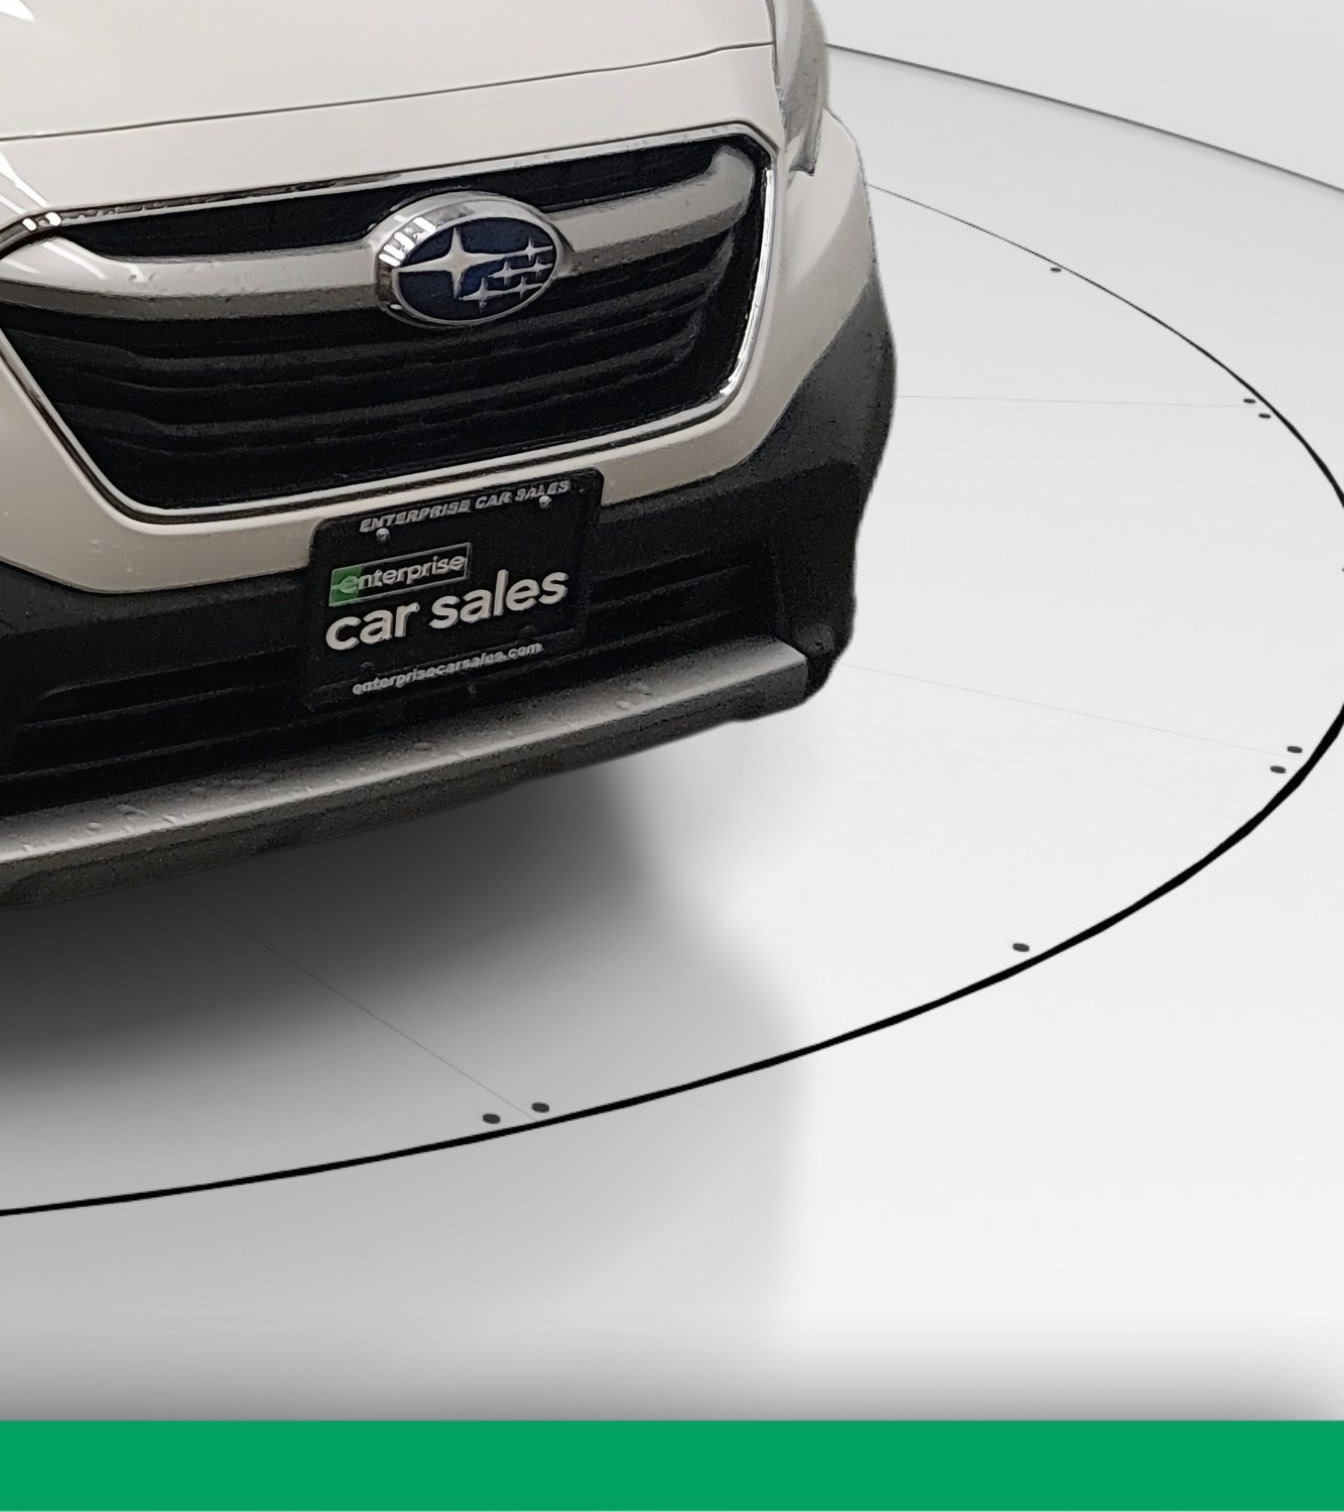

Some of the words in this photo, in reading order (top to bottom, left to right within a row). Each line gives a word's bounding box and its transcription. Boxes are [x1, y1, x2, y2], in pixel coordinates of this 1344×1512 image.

[359, 499, 471, 533] ENTERPRISE
[475, 492, 512, 509] CAR
[515, 479, 570, 502] SALES
[337, 553, 466, 594] enterprise
[325, 602, 419, 651] car
[428, 569, 569, 629] sales
